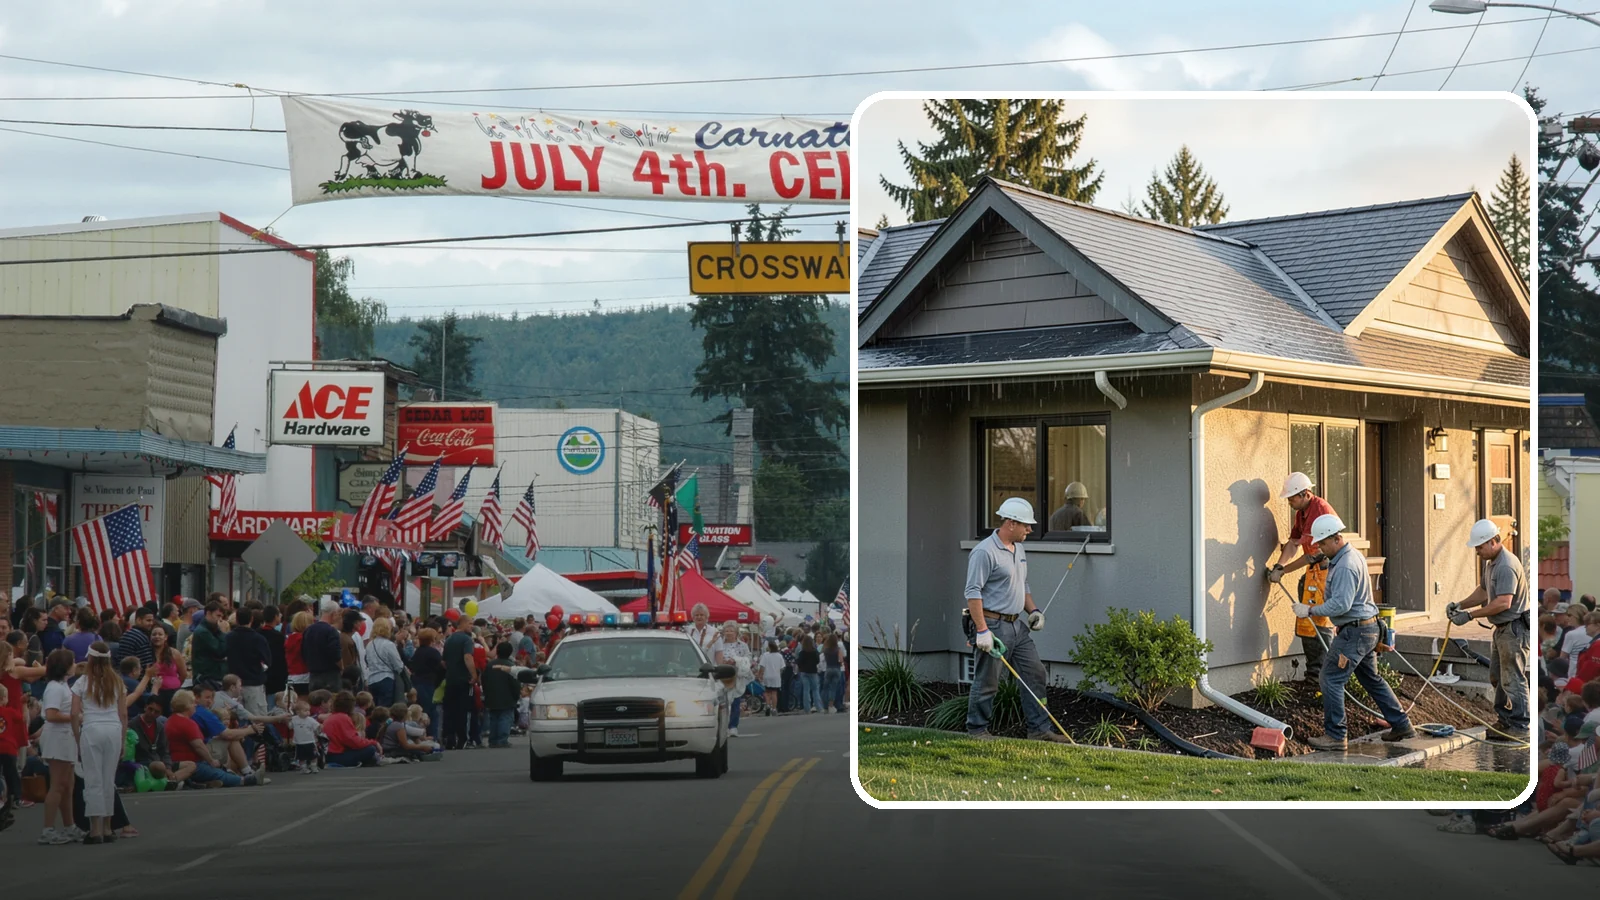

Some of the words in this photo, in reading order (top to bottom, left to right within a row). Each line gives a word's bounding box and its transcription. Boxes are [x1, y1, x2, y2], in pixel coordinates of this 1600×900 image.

[694, 121, 850, 150] Carnat
[481, 141, 605, 192] JULY
[632, 150, 746, 198] 4th.
[697, 254, 850, 280] CROSSWA
[283, 380, 373, 419] ACE
[405, 409, 453, 422] CEDAR
[461, 409, 485, 422] LOG
[284, 421, 370, 436] Hardware
[83, 485, 93, 494] St.
[95, 485, 124, 495] Vincent
[126, 485, 135, 495] de
[137, 485, 155, 495] Paul
[212, 515, 330, 535] HARDARE
[688, 526, 741, 535] CRNATION
[699, 535, 730, 543] GLASS
